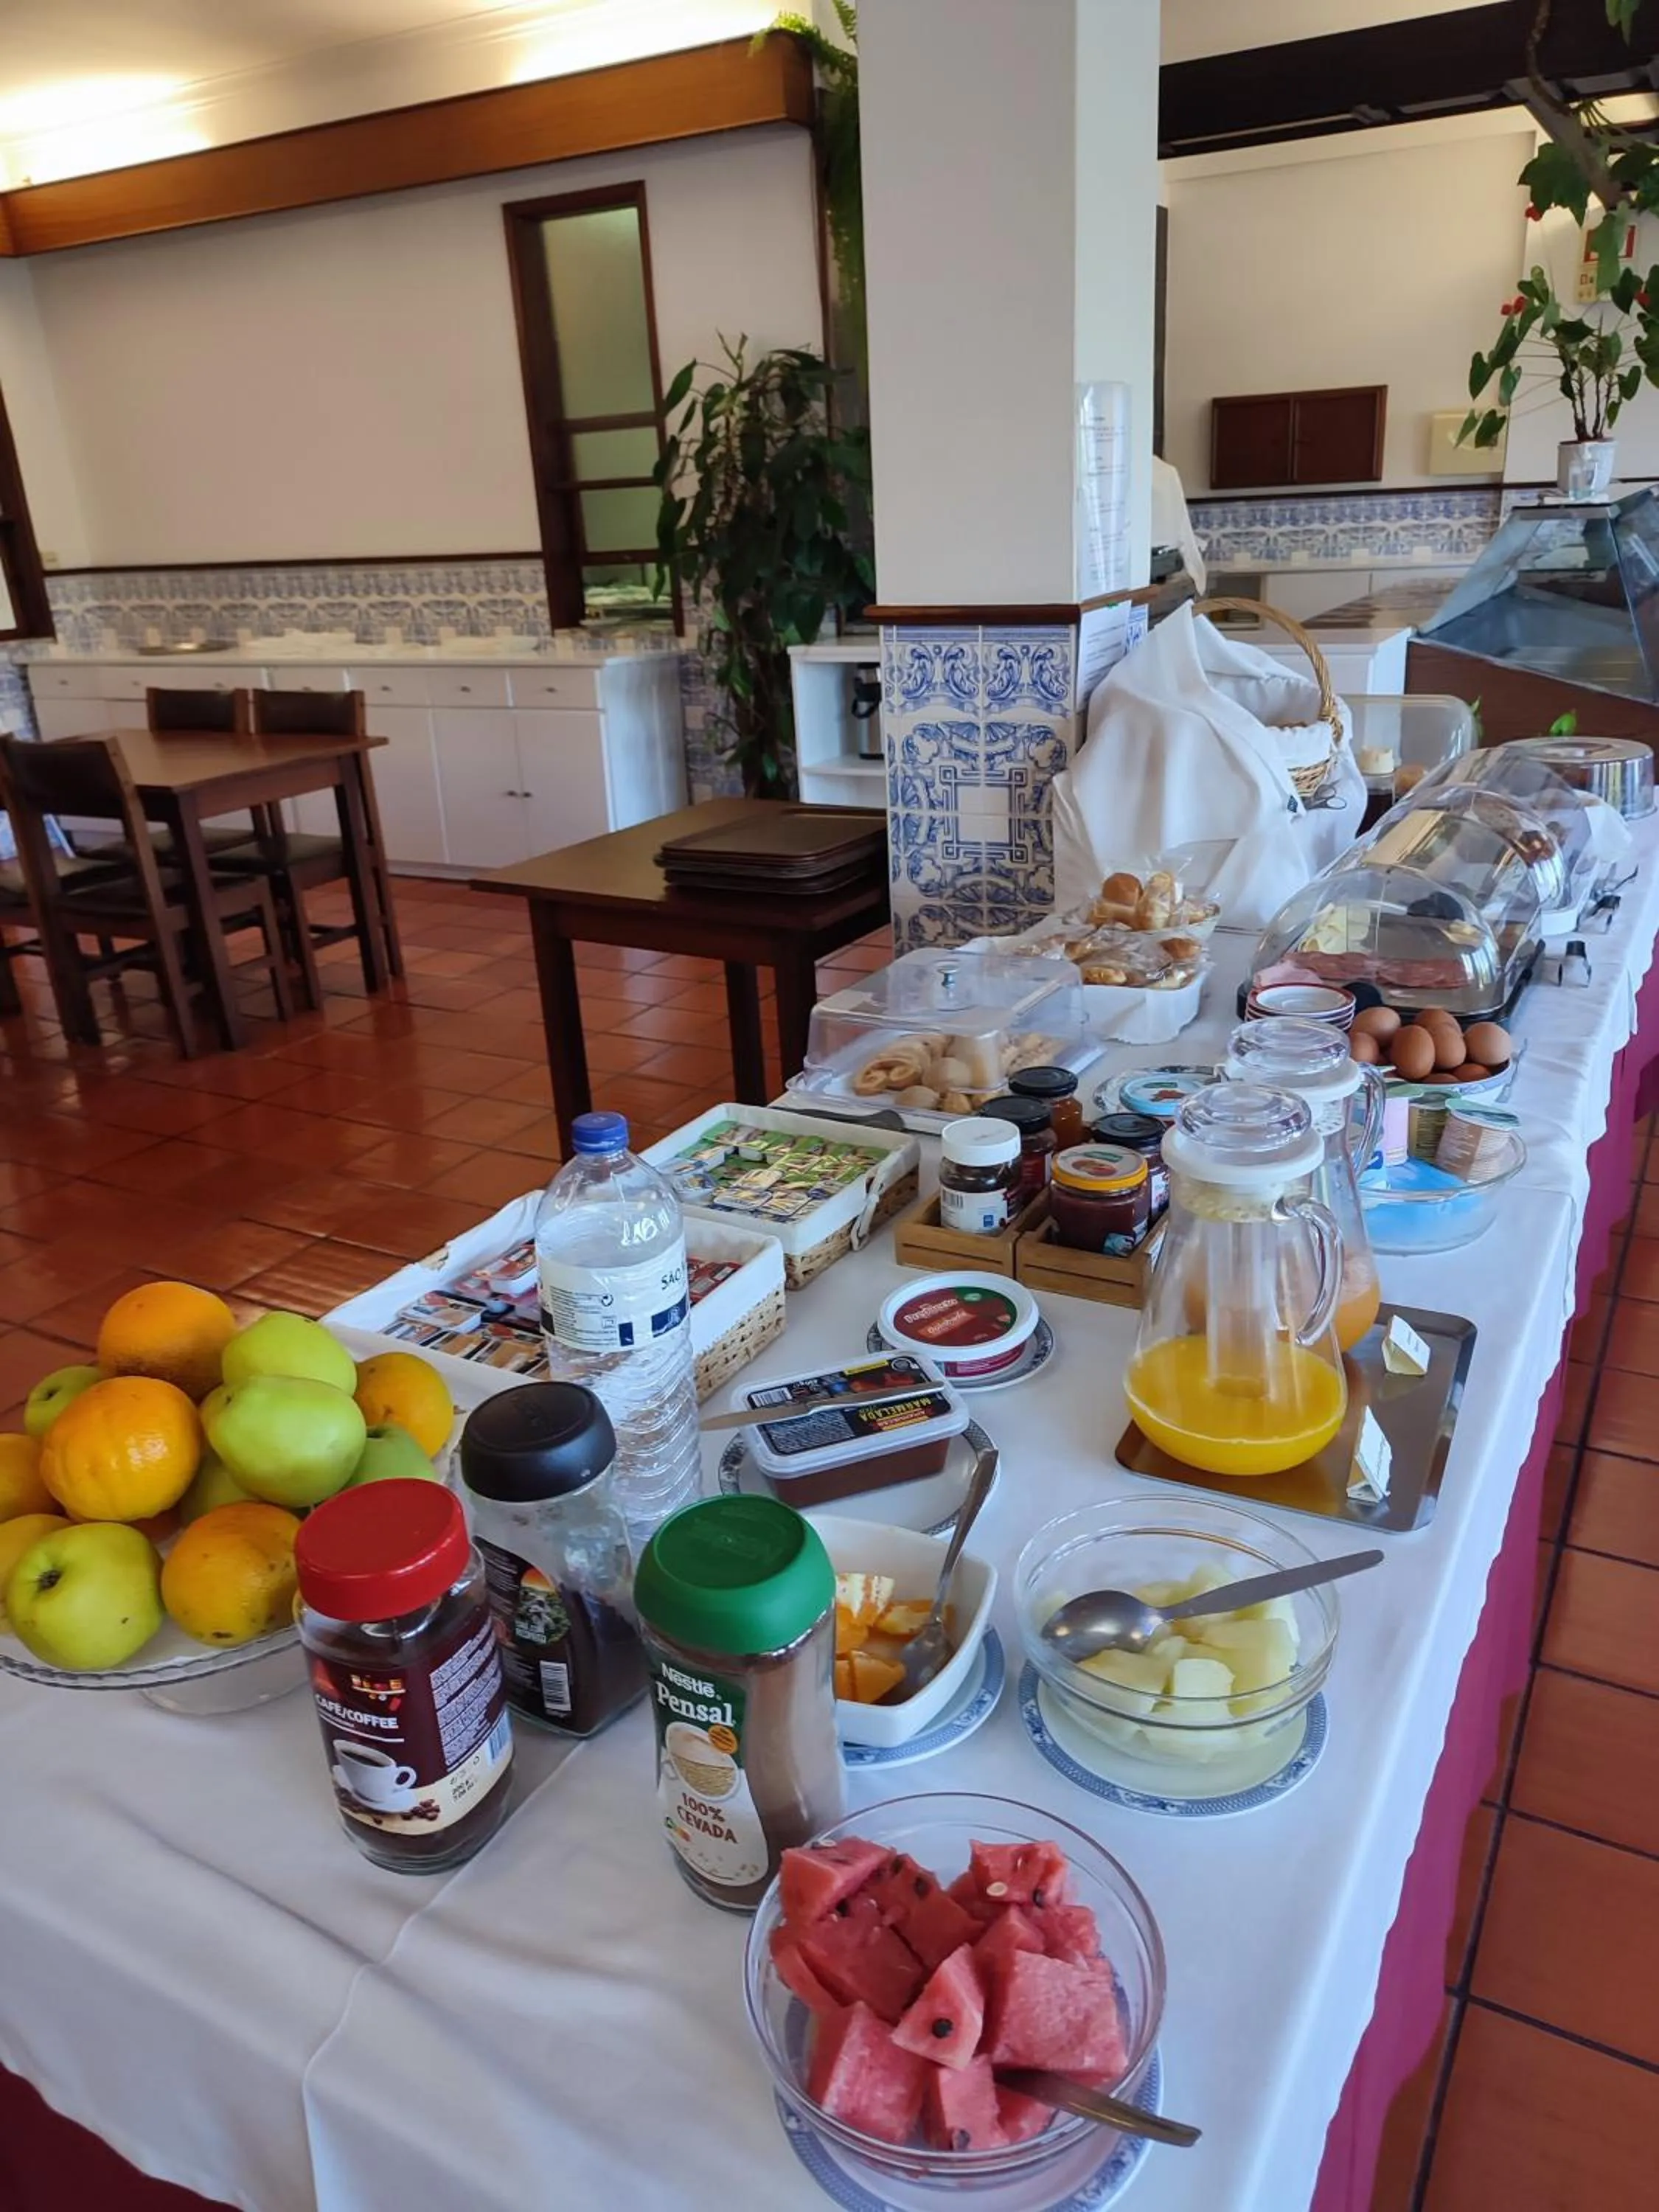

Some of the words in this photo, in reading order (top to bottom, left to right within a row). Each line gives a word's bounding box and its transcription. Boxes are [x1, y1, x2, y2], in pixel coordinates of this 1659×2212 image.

[661, 1662, 716, 1698] Nestlé
[655, 1680, 735, 1727] Pensal
[676, 1805, 739, 1844] CEVADA
[681, 1792, 726, 1823] 100%
